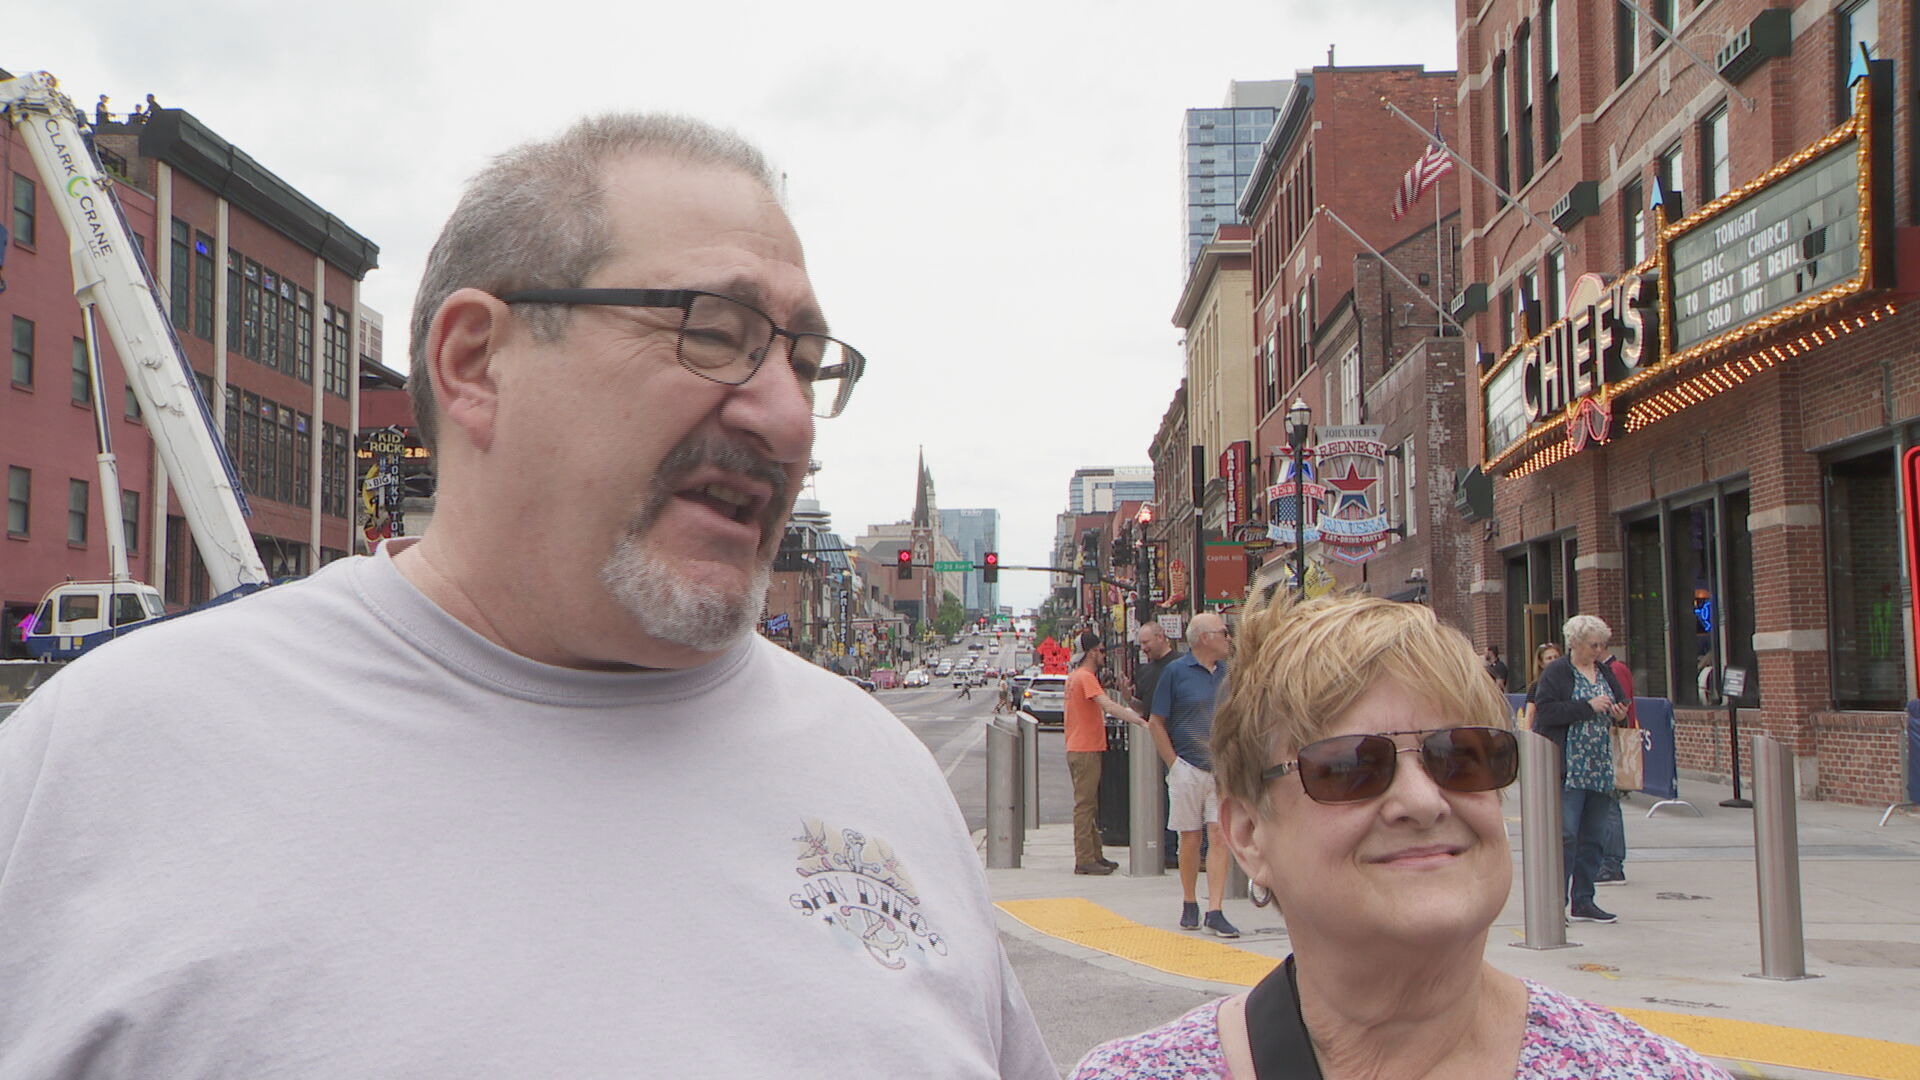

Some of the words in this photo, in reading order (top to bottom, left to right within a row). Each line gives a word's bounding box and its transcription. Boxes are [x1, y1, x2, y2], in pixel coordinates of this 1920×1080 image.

[46, 119, 78, 177] CLARK
[80, 196, 113, 257] CRANE
[88, 240, 102, 260] LLC
[1701, 255, 1725, 283] ERIC
[1747, 219, 1790, 257] CHURCH
[1714, 208, 1759, 251] TONIGHT
[1685, 296, 1699, 317] TO
[1708, 276, 1734, 305] BEAT
[1741, 264, 1761, 291] THE
[1767, 242, 1801, 278] DEVIL
[1706, 305, 1732, 333] SOLD
[1743, 287, 1765, 314] OUT
[1522, 274, 1645, 423] CHIEF'S
[378, 433, 400, 443] KID
[1319, 440, 1385, 460] REDNECK
[1325, 430, 1347, 438] JOHN
[1349, 429, 1377, 438] RICH'S
[391, 455, 400, 505] HONKY
[1270, 483, 1325, 499] REDECK
[1325, 533, 1338, 541] EAT
[1206, 555, 1229, 563] Capitol
[789, 876, 848, 917] SAN
[856, 878, 949, 957] DIEGO
